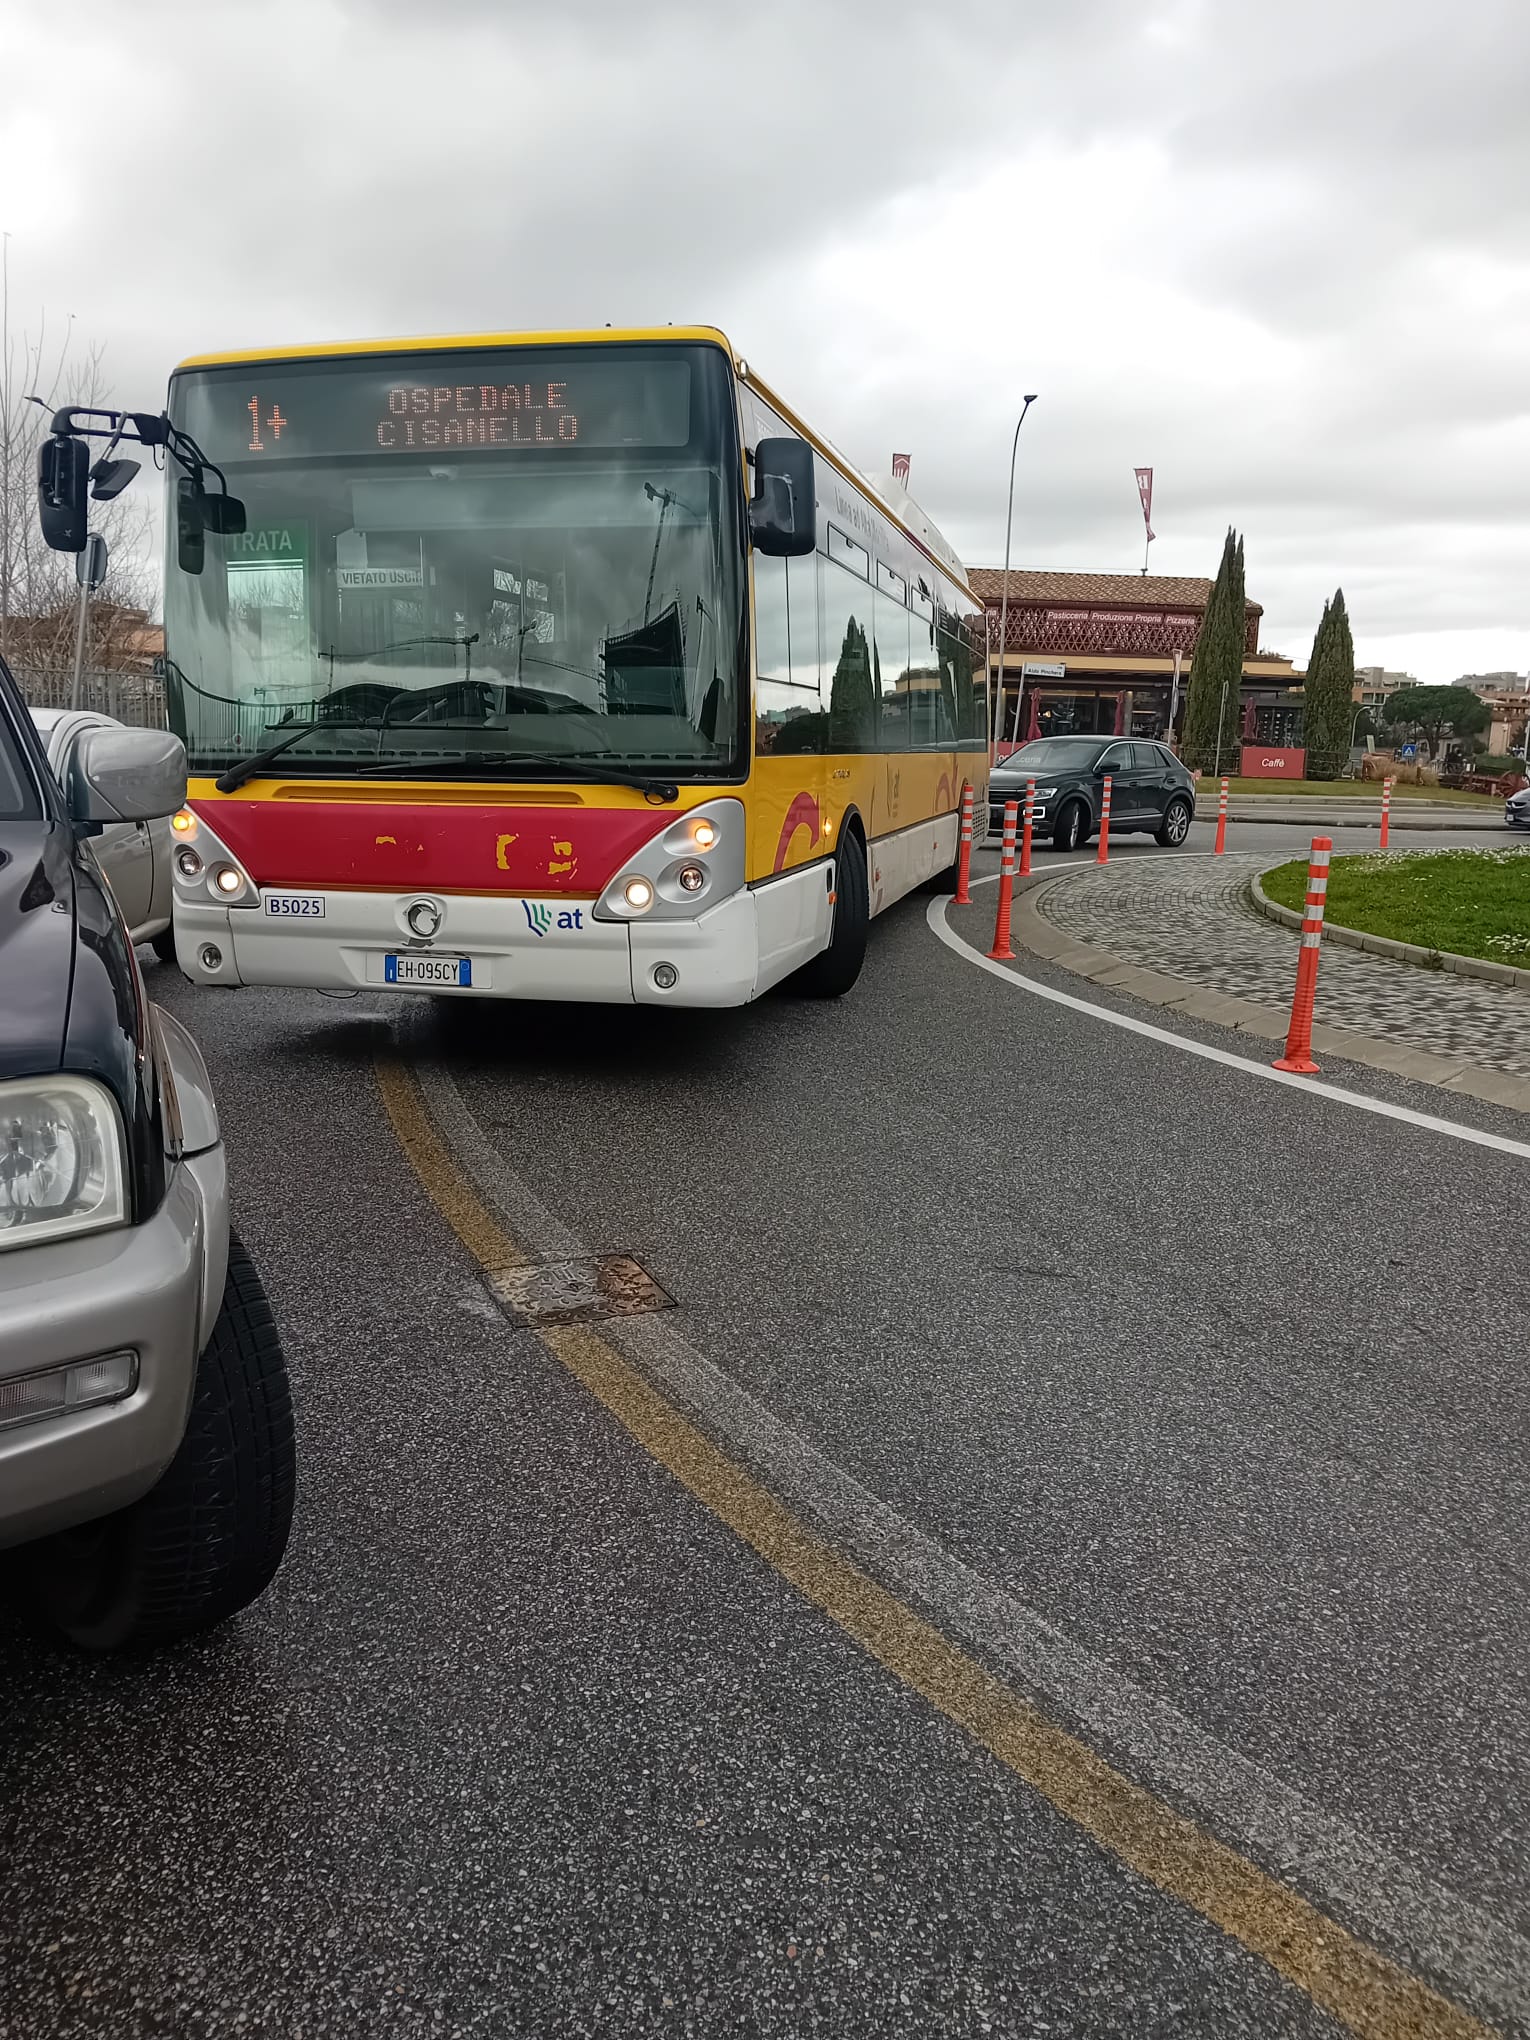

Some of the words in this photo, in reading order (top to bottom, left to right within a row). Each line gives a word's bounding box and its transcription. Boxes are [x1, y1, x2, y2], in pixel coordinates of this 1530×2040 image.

[389, 382, 567, 414] OSPEDALE
[247, 395, 287, 451] 1+
[377, 414, 577, 446] CISANELLO
[229, 529, 293, 552] TRATA
[342, 572, 386, 585] VIETATO
[1047, 611, 1088, 620] Pasticceria
[1091, 612, 1133, 622] Produzione
[1135, 614, 1161, 624] Propria
[1165, 615, 1196, 625] Pizzeria
[1261, 758, 1285, 768] Caffè
[270, 899, 320, 914] B5025
[557, 908, 584, 929] at
